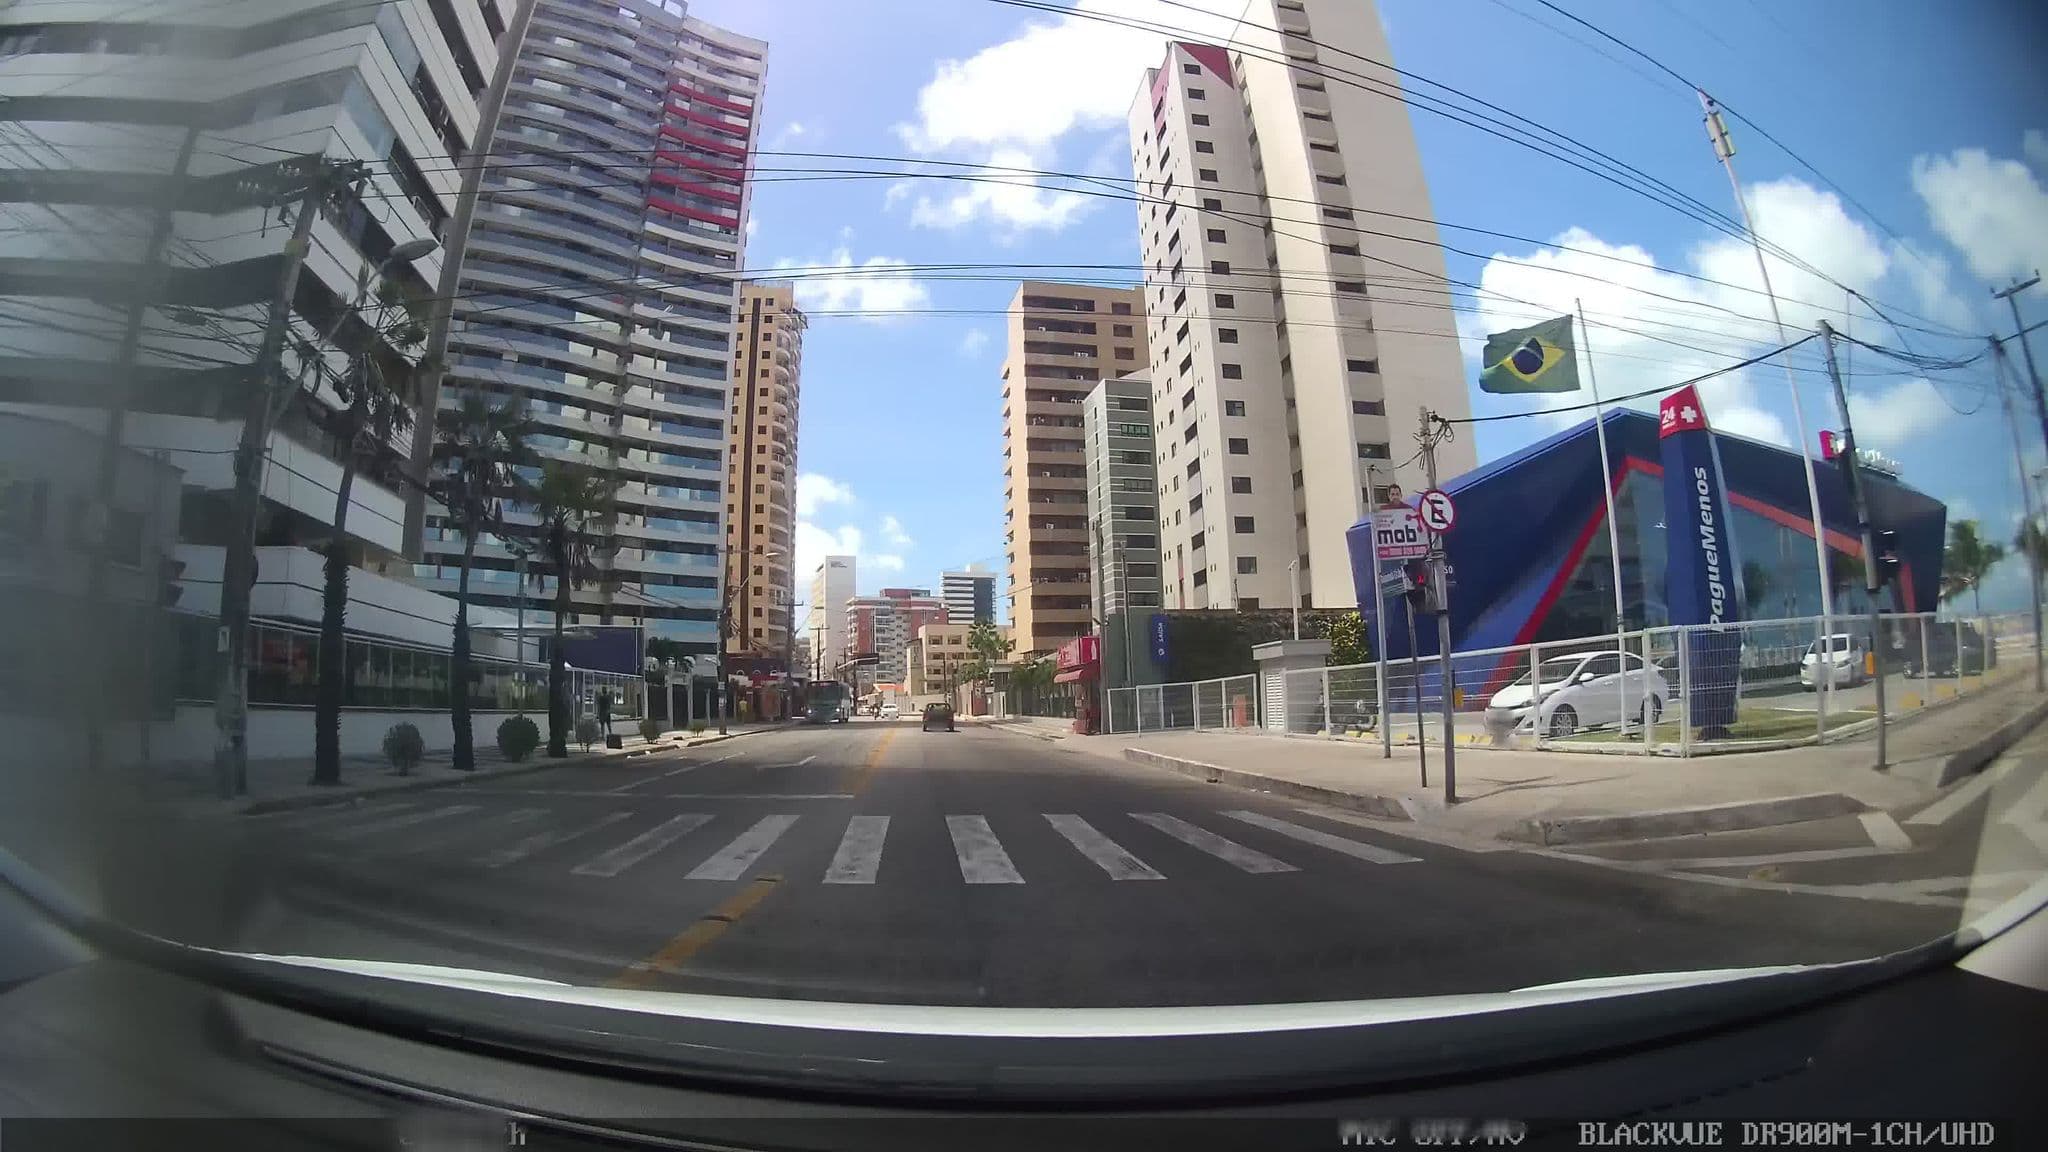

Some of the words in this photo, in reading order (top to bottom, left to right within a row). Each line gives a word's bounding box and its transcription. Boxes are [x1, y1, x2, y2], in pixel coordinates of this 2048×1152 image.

[1661, 406, 1676, 425] 24
[1377, 525, 1418, 545] mob
[1694, 466, 1726, 633] PagueMenos
